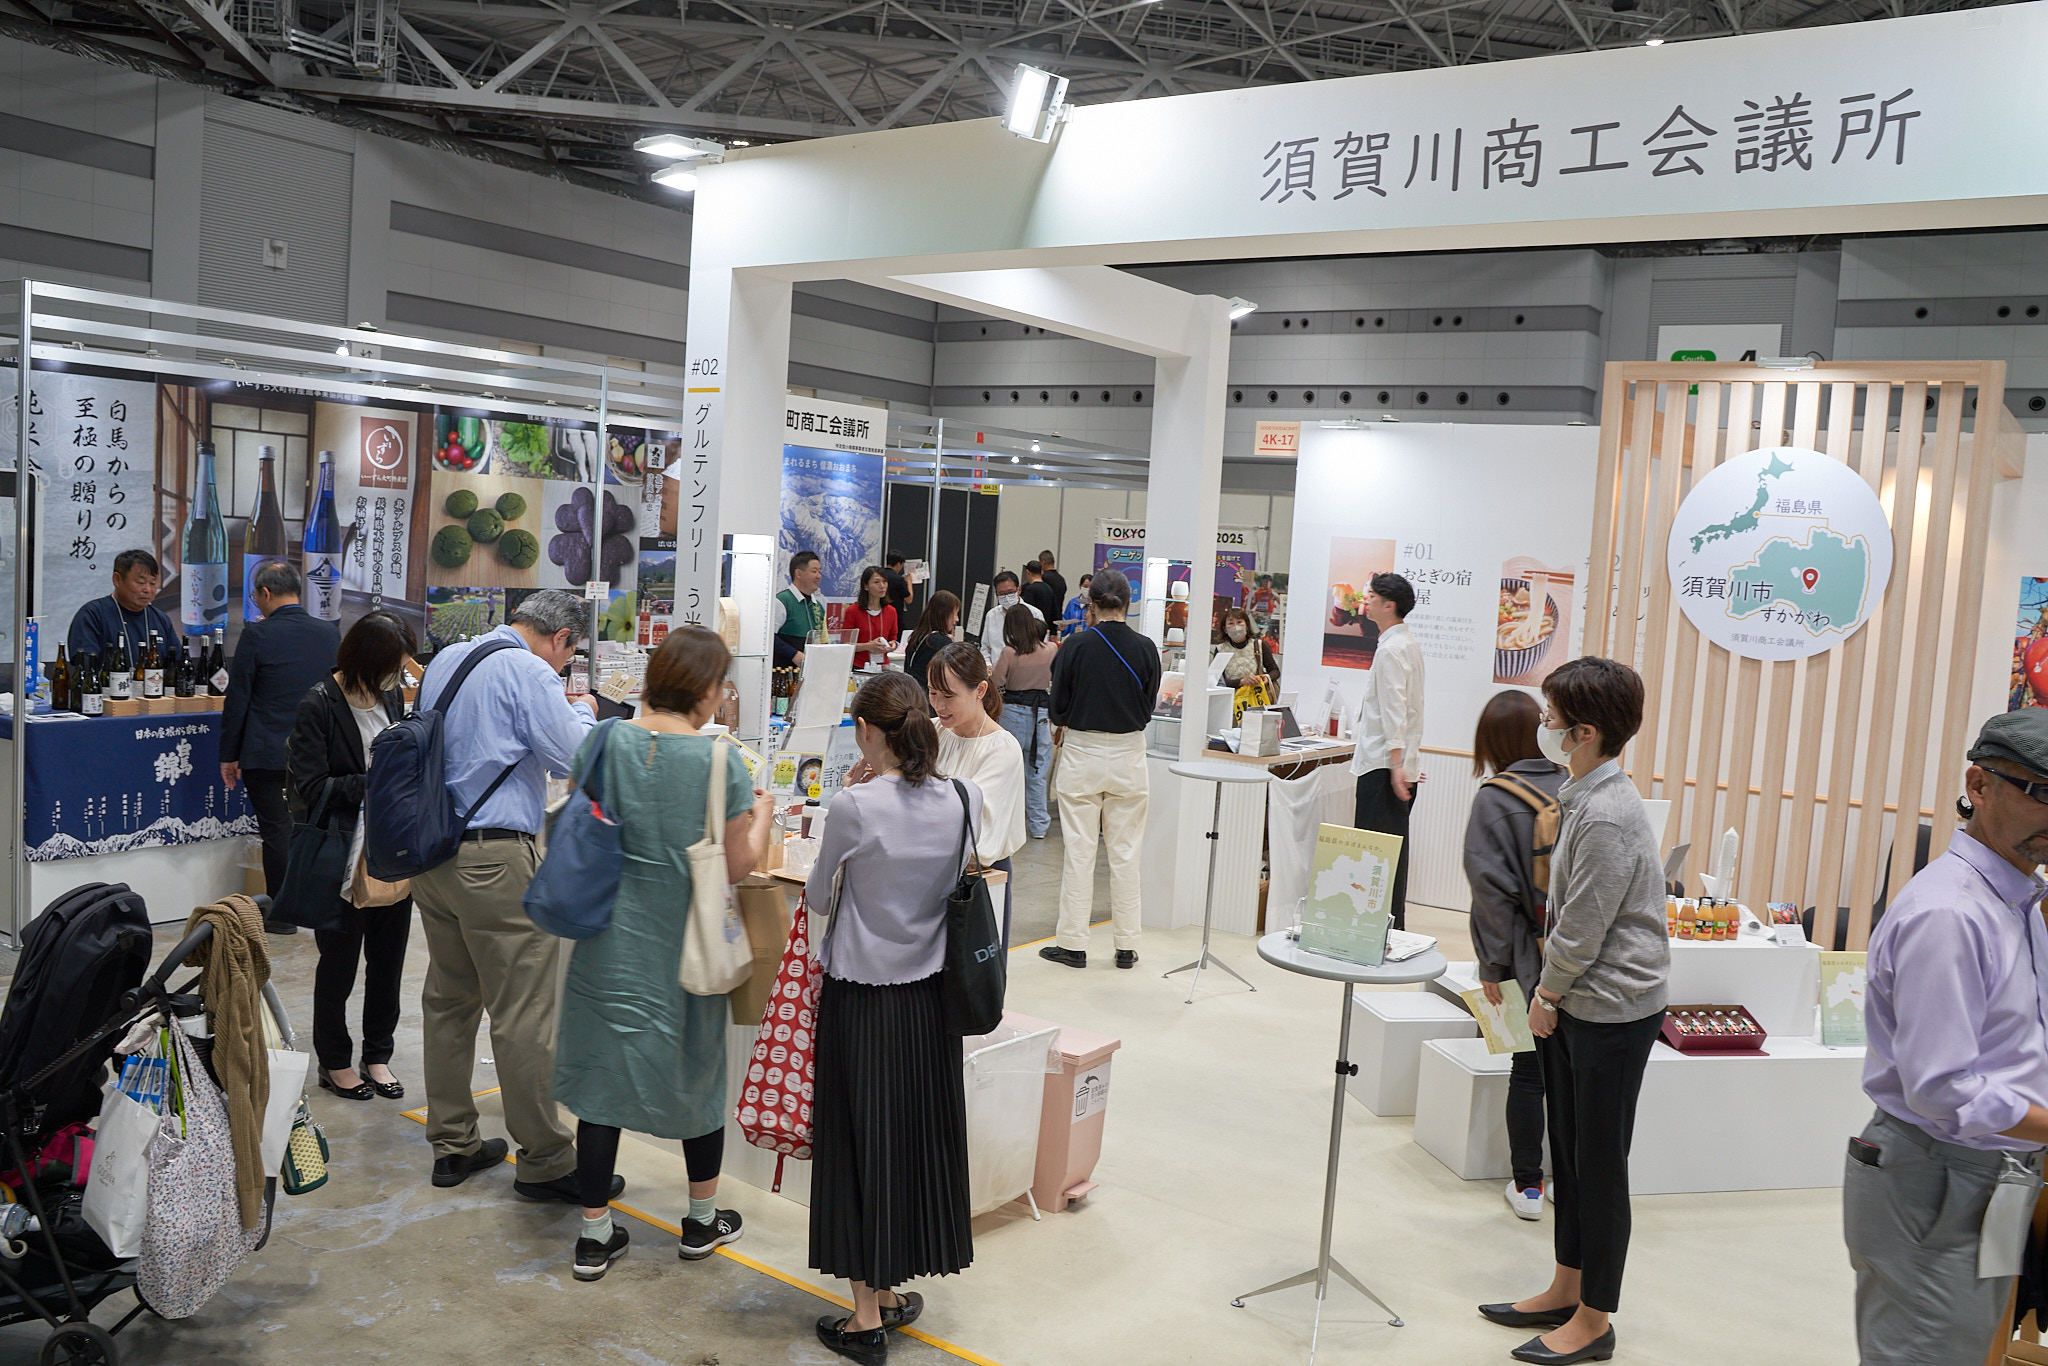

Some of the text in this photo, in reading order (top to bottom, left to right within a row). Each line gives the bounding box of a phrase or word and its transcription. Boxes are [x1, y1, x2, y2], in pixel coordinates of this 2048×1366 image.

[1259, 87, 1922, 204] 須賀川商工会議所
[691, 358, 718, 376] #02
[1262, 434, 1295, 446] 4K-17
[106, 400, 129, 531] 白馬からの
[69, 397, 99, 571] 至極の贈り物。
[691, 402, 712, 573] グルテンフリー
[1775, 498, 1823, 515] 福島県
[1106, 527, 1146, 539] TOKYO
[1403, 543, 1434, 560] #01
[1403, 567, 1472, 586] おとぎの宿
[1681, 576, 1774, 602] 須賀川市
[1760, 607, 1831, 627] すかがわ
[1730, 633, 1805, 648] 須賀川商工会議所
[1367, 865, 1382, 909] 須賀川市
